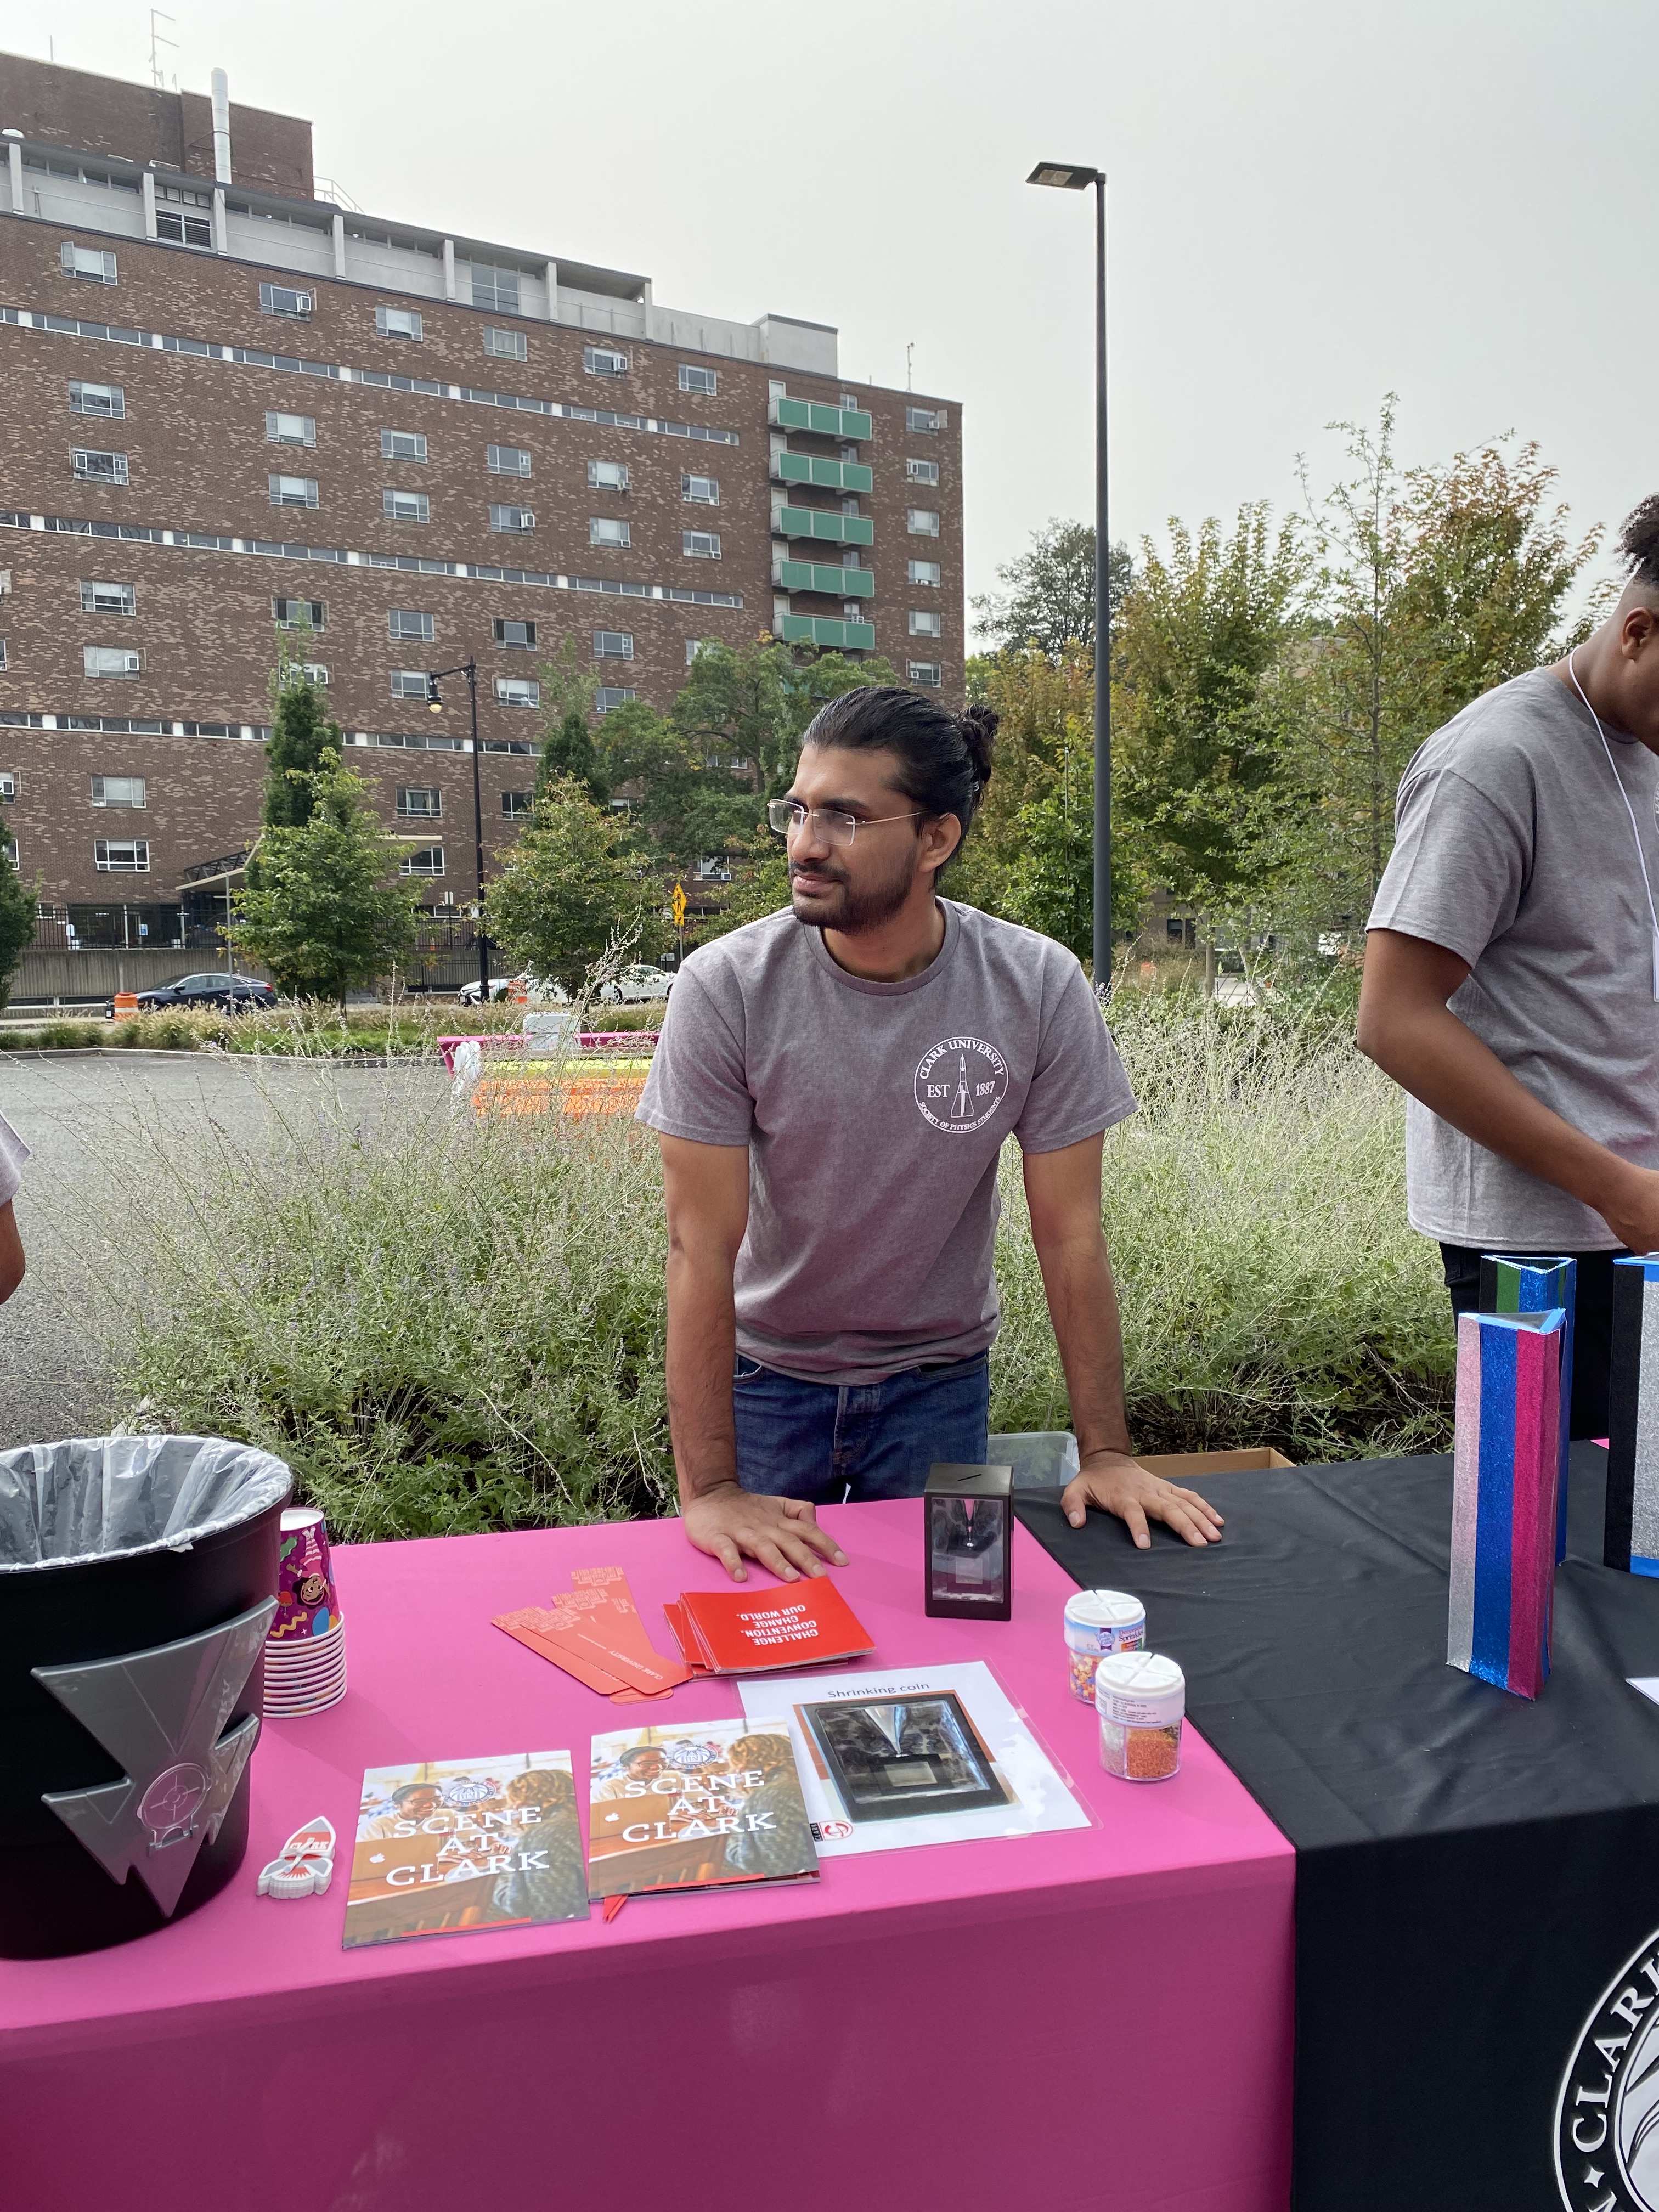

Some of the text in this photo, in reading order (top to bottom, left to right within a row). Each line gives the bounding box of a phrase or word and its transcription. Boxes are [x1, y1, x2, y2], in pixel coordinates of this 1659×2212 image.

[919, 1039, 1005, 1080] CLARK UNIVERSITY
[927, 1081, 996, 1098] EST 1887
[919, 1101, 940, 1125] SOCIETY
[940, 1121, 950, 1129] OF
[950, 1122, 977, 1131] PHYSICS
[736, 1605, 806, 1621] OUR WORLD.
[752, 1615, 799, 1628] CHANGE
[740, 1620, 817, 1638] CONVENTION.
[752, 1629, 819, 1646] CHALLENGE
[608, 1650, 663, 1680] CLARK UNIVERSITY
[828, 1683, 930, 1698] Shrinking coin
[624, 1770, 765, 1798] SCENE
[667, 1796, 725, 1816] AT
[393, 1807, 541, 1838] SCENE
[622, 1812, 777, 1843] CLARK
[810, 1823, 822, 1841] CLARK
[436, 1833, 499, 1857] AT
[386, 1850, 550, 1886] CLARK
